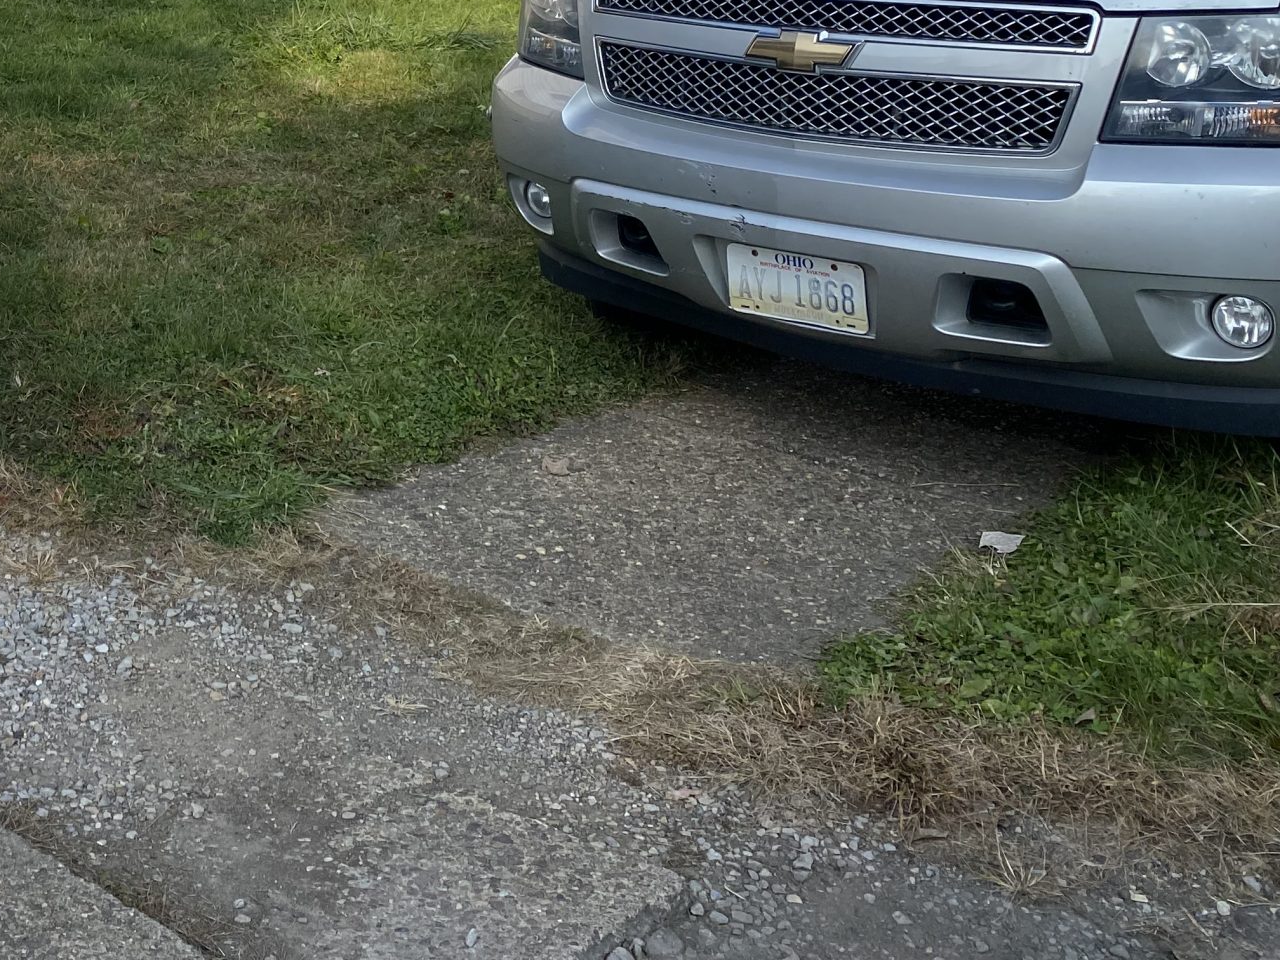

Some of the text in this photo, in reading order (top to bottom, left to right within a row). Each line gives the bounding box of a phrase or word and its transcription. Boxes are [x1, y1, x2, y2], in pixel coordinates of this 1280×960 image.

[775, 252, 814, 270] OHIO
[739, 265, 782, 304] AYJ
[794, 273, 856, 316] 1868
